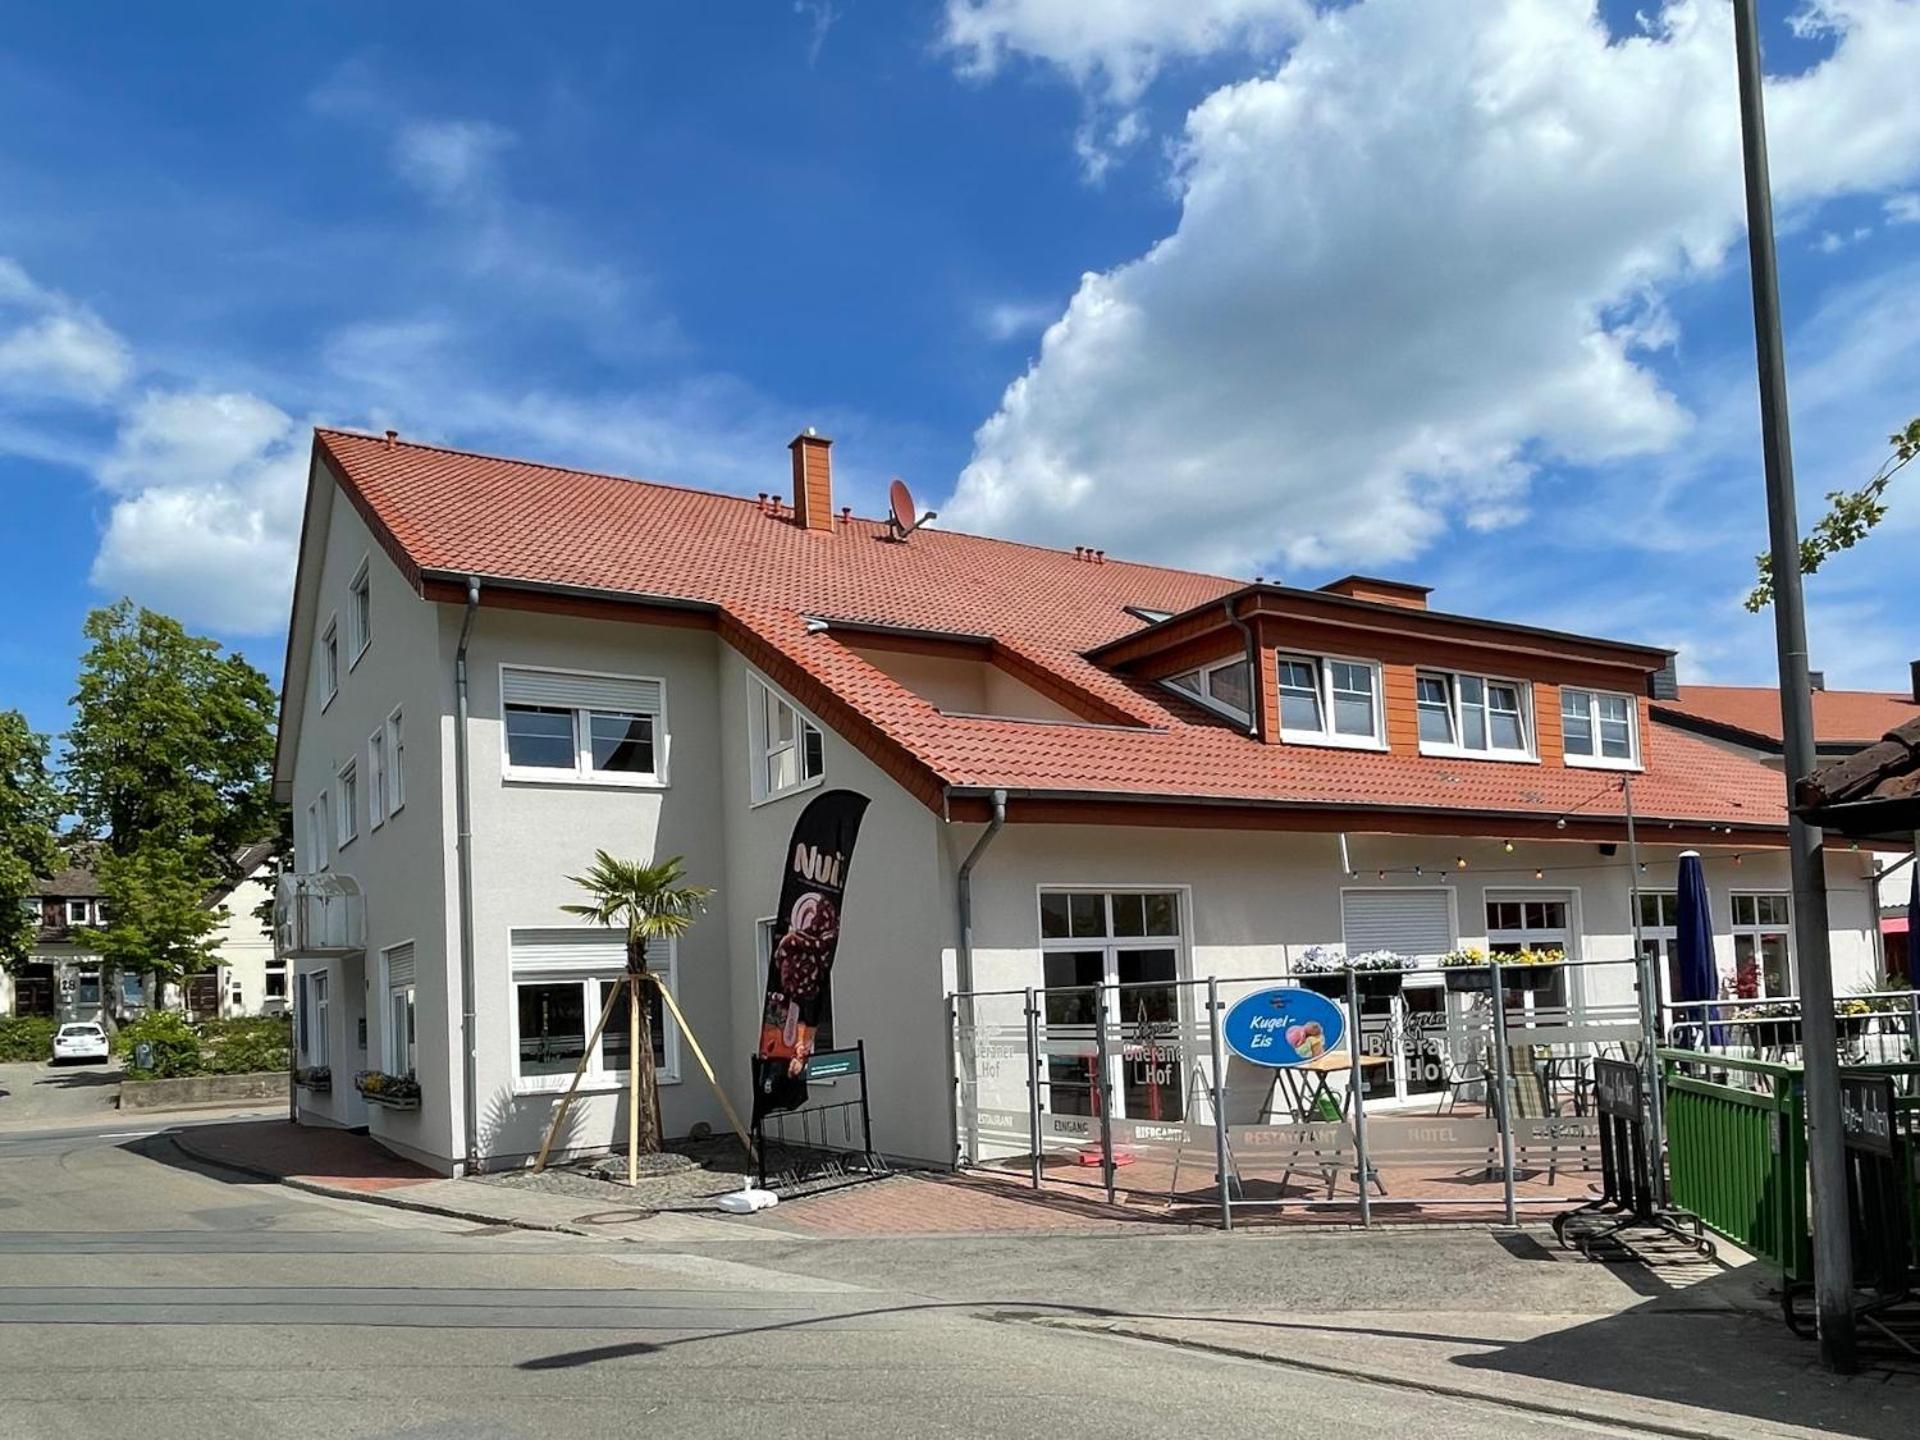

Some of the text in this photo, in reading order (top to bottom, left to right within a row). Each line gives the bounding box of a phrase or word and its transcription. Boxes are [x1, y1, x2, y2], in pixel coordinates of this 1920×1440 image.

[1250, 1015, 1296, 1032] Kugel-
[1250, 1034, 1273, 1048] Eis
[1145, 1063, 1173, 1086] Hof
[1054, 1119, 1089, 1132] EINGANG
[1408, 1127, 1458, 1142] HOTEL
